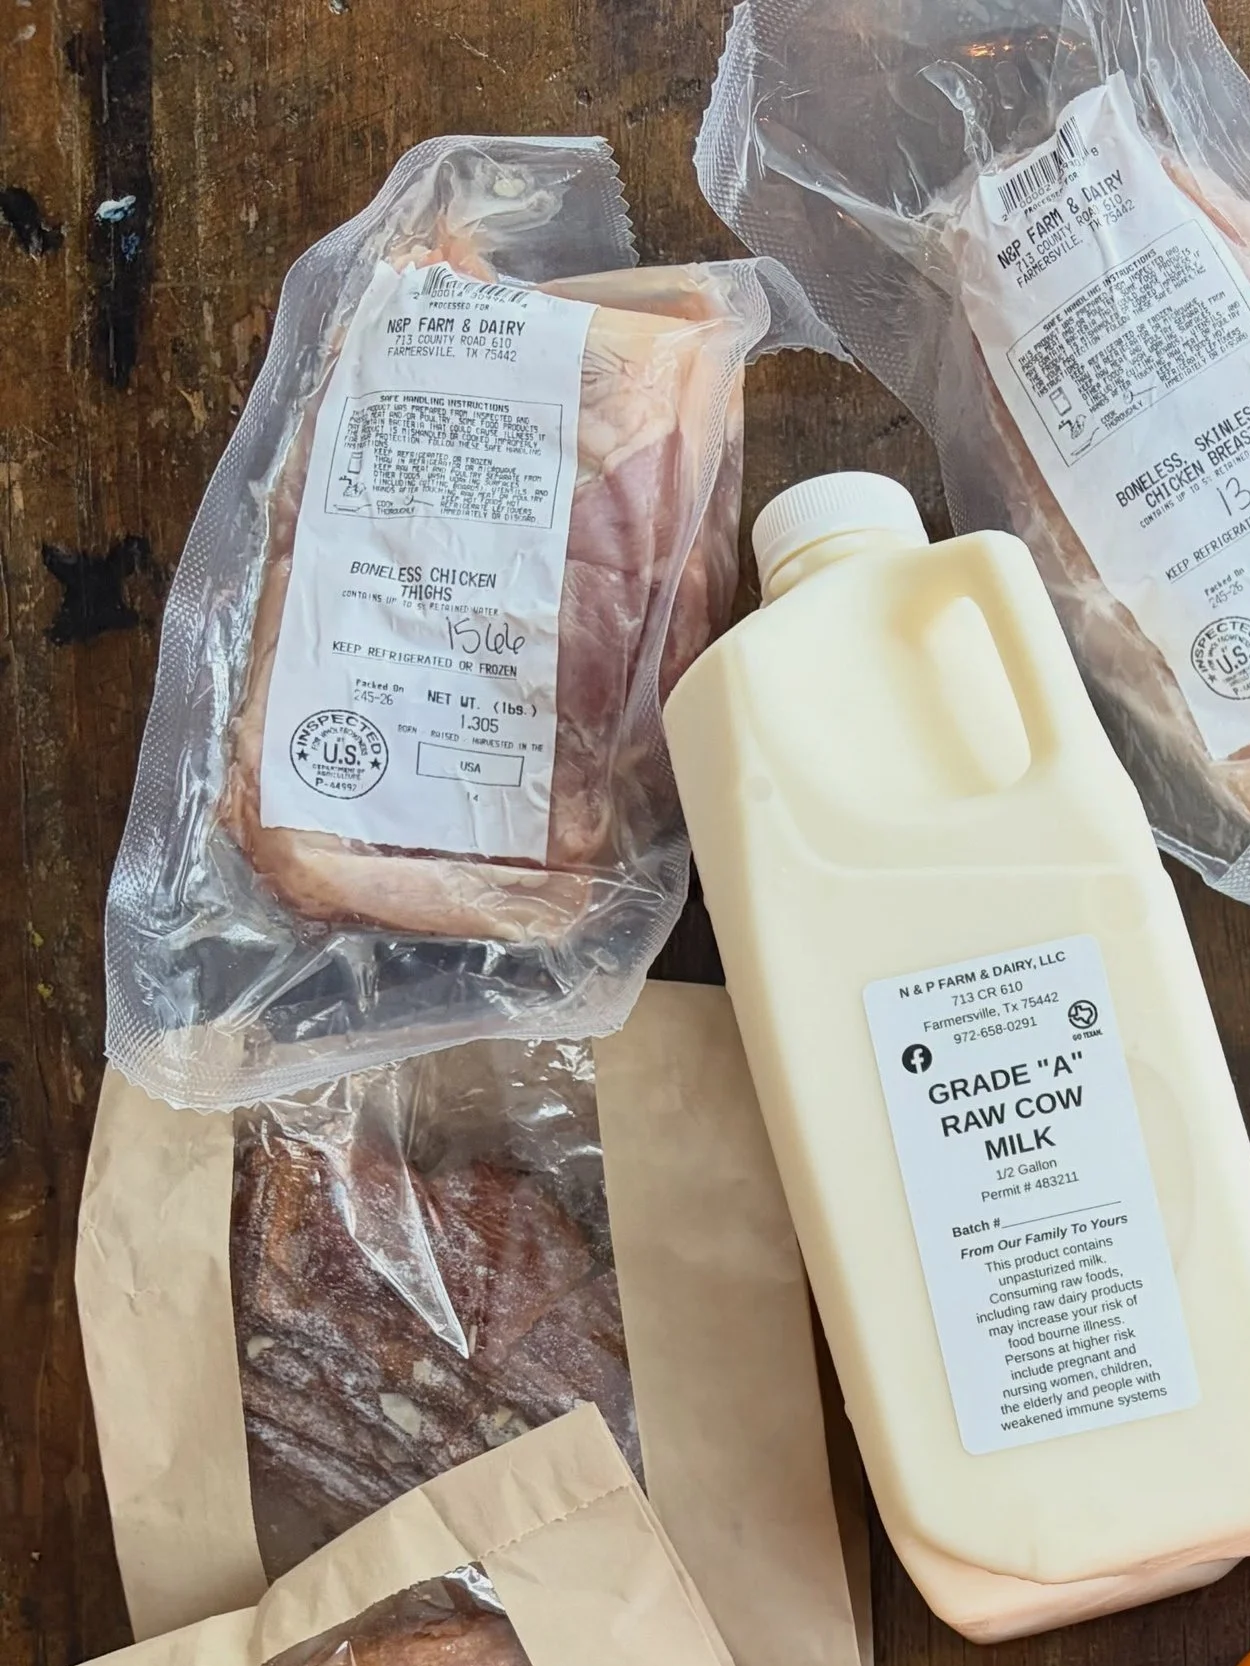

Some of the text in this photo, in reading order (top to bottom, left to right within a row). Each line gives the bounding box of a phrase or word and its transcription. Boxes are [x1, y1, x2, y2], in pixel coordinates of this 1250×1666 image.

[997, 169, 1124, 269] N&P FARM & DAIRY
[1087, 218, 1102, 233] TX
[1103, 198, 1136, 225] 75442
[386, 316, 526, 337] N&P FARM & DAIRY
[395, 334, 512, 349] 713 COUNTY ROAD 610
[466, 347, 478, 358] TX
[484, 348, 517, 363] 75442
[1141, 459, 1206, 509] CHICKEN
[350, 560, 497, 589] BONELESS CHICKEN
[1165, 558, 1189, 581] KEEP
[401, 581, 453, 602] THIGHS
[332, 640, 517, 677] KEEP REFRIGERATED OR FROZEN
[427, 689, 452, 705] NET
[296, 710, 385, 755] INSPECTED
[461, 714, 499, 734] 1.305
[323, 741, 363, 766] U.S.
[460, 760, 481, 774] USA
[899, 951, 1066, 999] N & P FARM & DAIRY, LLC
[951, 980, 1023, 1007] 713 CR 610
[923, 991, 1060, 1033] Farmersville, Tx 75442
[953, 1016, 1038, 1045] 972-658-0291
[1072, 1033, 1083, 1042] GO
[928, 1050, 1083, 1105] GRADE "A"
[940, 1085, 1083, 1138] RAW COW
[984, 1125, 1056, 1161] MILK
[980, 1171, 1079, 1203] Permit # 483211
[996, 1159, 1058, 1181] 1/2 Gallon
[951, 1220, 991, 1238] Batch
[960, 1214, 1128, 1260] From Our Family To Yours
[984, 1237, 1114, 1273] This product contains
[998, 1254, 1107, 1287] unpasturized milk.
[975, 1279, 1144, 1324] including raw dairy products
[989, 1267, 1124, 1305] Consuming raw foods,
[988, 1294, 1138, 1337] may increase your risk of
[1007, 1316, 1125, 1349] food bourne illness.
[1004, 1327, 1136, 1366] Persons at higher risk
[1010, 1342, 1137, 1381] include pregnant and
[1000, 1370, 1161, 1415] the elderly and people with
[1002, 1359, 1152, 1399] nursing women, children,
[1000, 1387, 1168, 1432] weakened immune systems
